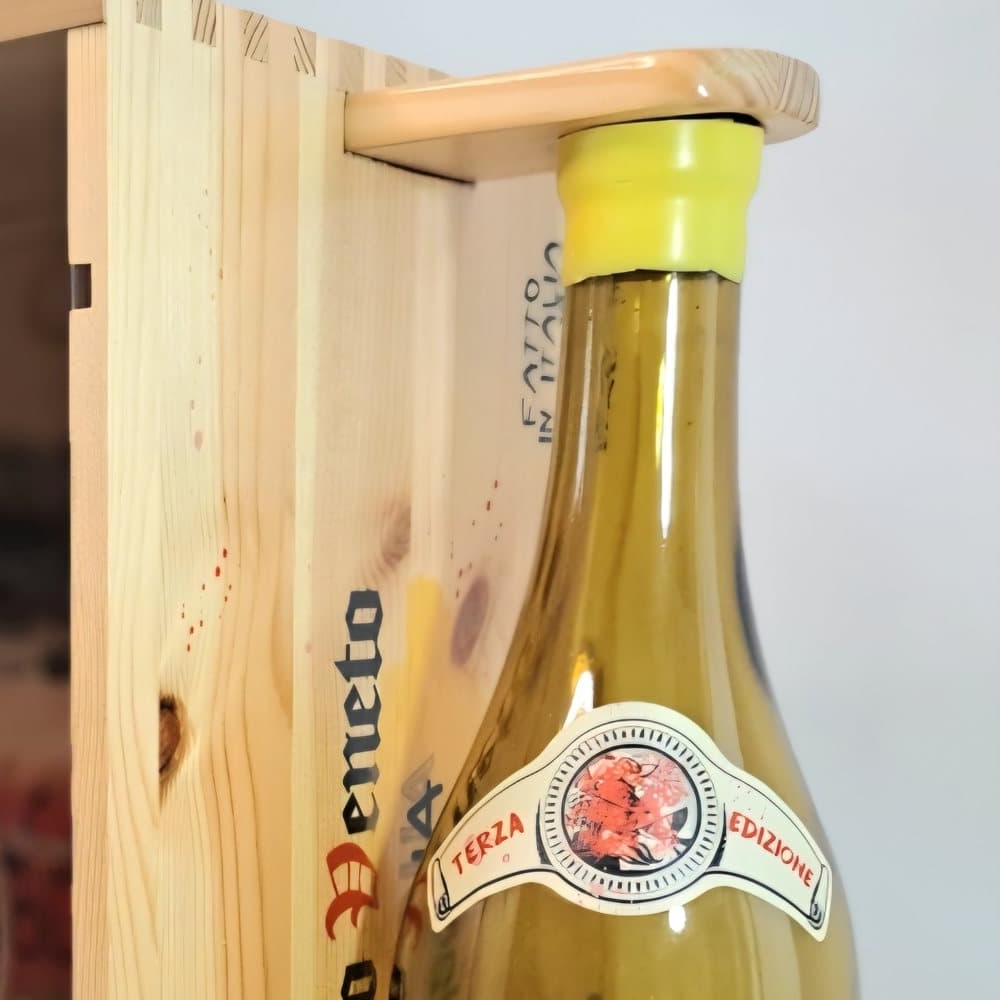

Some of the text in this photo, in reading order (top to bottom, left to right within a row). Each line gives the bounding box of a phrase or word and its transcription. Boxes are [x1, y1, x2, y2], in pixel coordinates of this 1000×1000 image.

[521, 278, 541, 426] FATTO
[538, 410, 553, 443] IN
[451, 811, 525, 875] TERZA
[729, 811, 814, 888] EDIZIONE
